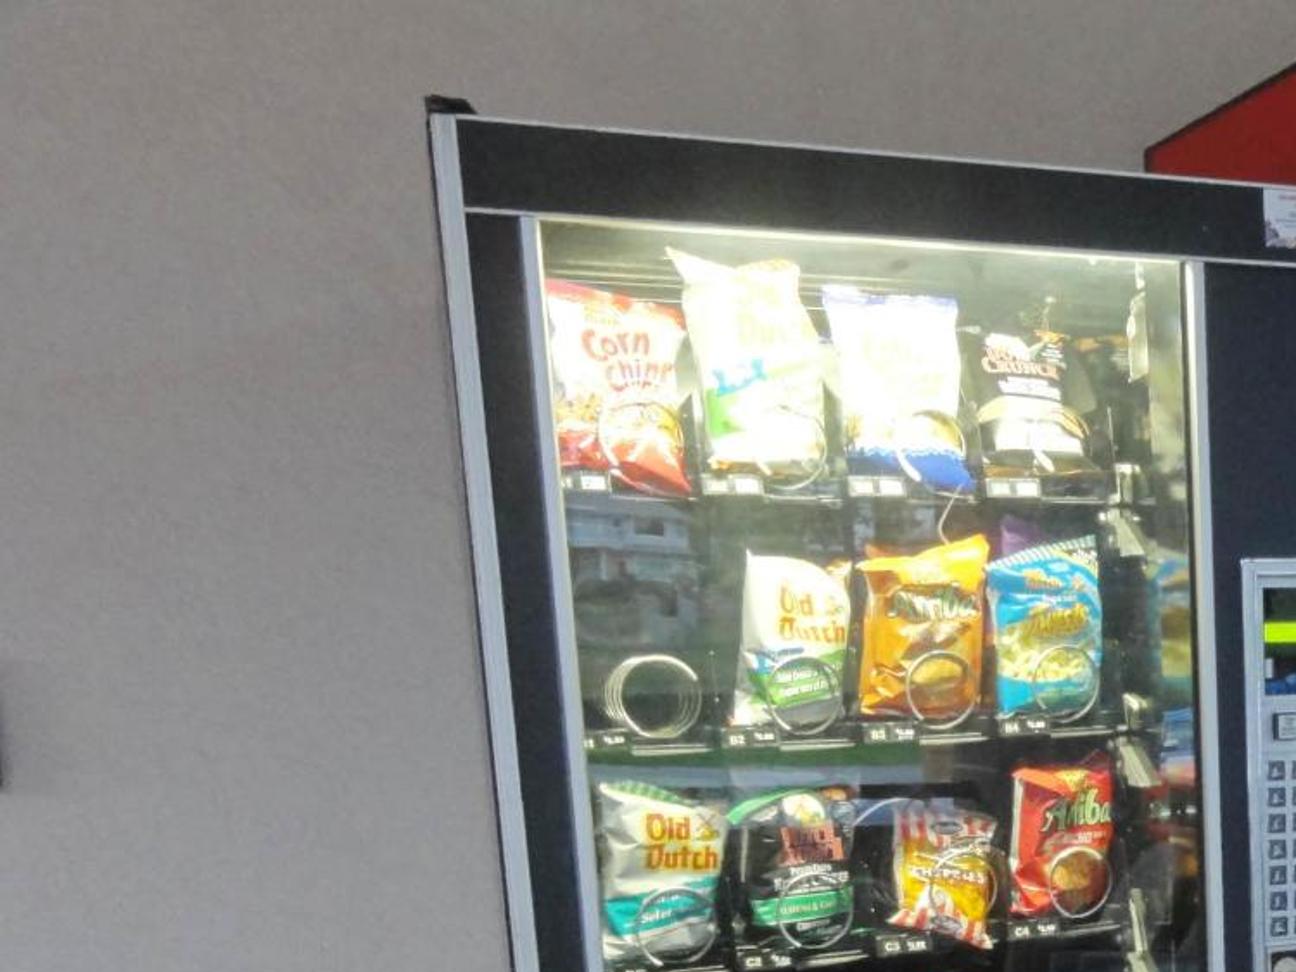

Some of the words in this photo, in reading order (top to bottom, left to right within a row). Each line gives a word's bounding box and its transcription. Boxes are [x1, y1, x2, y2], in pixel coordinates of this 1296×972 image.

[580, 328, 650, 362] Corn
[645, 813, 691, 841] Old
[644, 844, 719, 871] Dutch
